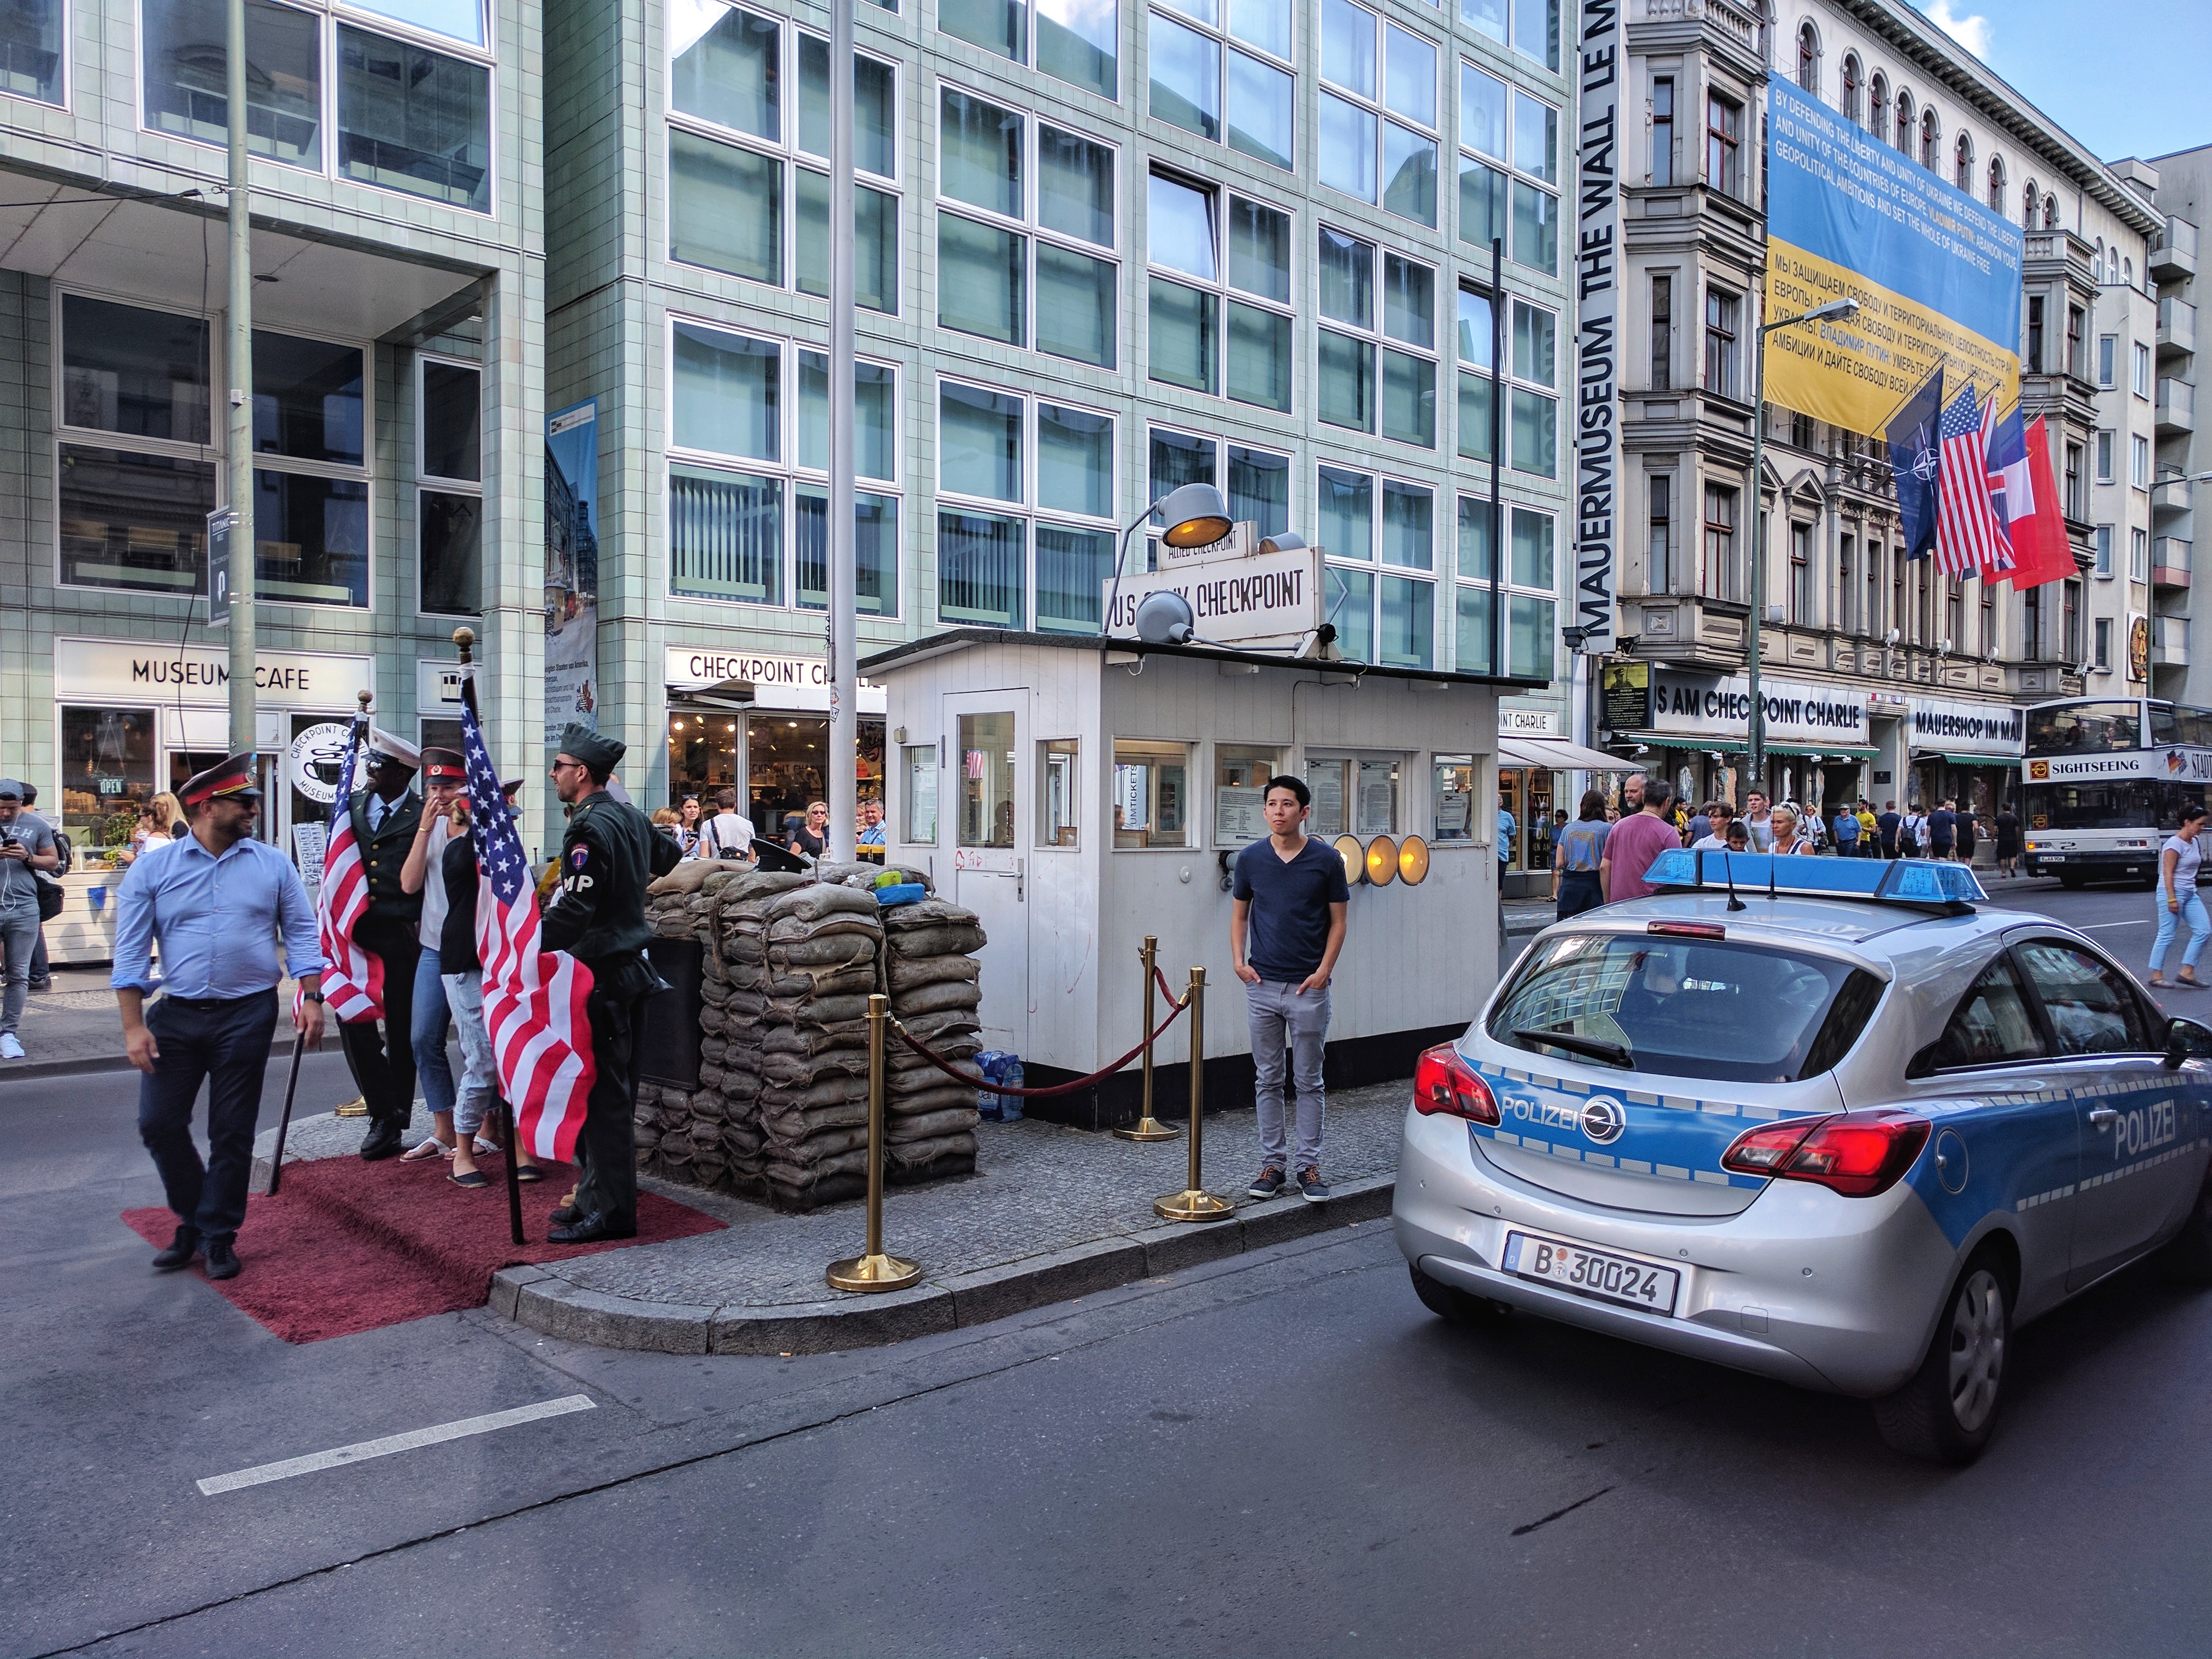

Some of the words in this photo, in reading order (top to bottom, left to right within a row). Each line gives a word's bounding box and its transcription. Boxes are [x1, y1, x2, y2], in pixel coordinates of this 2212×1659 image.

[1584, 44, 1615, 93] LE
[1582, 104, 1614, 222] WALL
[1775, 88, 1788, 109] BY
[1789, 97, 1834, 138] DEFENDING
[1836, 126, 1850, 149] THE
[1851, 136, 1880, 165] LIBERTY
[1881, 155, 1895, 176] AND
[1897, 162, 1916, 187] UNITY
[1917, 176, 1926, 192] OF
[1926, 182, 1952, 211] UKRAINE
[1953, 199, 1963, 217] WE
[1964, 205, 1987, 231] DEFEND
[1987, 219, 1997, 239] THE
[1998, 227, 2019, 251] LIBERTY
[1775, 115, 1794, 137] AND
[1796, 125, 1820, 152] UNITY
[1821, 140, 1832, 159] OF
[1833, 148, 1848, 170] THE
[1849, 159, 1889, 194] COUNTRIES
[1890, 182, 1900, 199] OF
[1928, 205, 1956, 234] VLADIMIR
[1976, 234, 2002, 262] ABANDON
[1775, 140, 1836, 187] GEOPOLITICAL
[1837, 174, 1876, 209] AMBITIONS
[1877, 196, 1892, 216] AND
[1893, 205, 1906, 224] SET
[1907, 212, 1920, 232] THE
[1921, 220, 1941, 246] WHOLE
[1942, 235, 1951, 250] OF
[1951, 239, 1976, 267] UKRAINE
[1977, 255, 1991, 276] FREE.
[1581, 224, 1612, 301] THE
[1775, 253, 1791, 274] МЫ
[1793, 261, 1845, 297] ЗАЩИЩАЕМ
[1847, 285, 1882, 313] СВОБОДУ
[1883, 302, 1888, 315] И
[1890, 304, 1954, 346] ТЕРРИТОРИАЛЬНУЮ
[1955, 336, 1995, 366] ЦЕЛОСТНОСТЬ
[1862, 316, 1895, 345] СВОБОДУ
[1898, 332, 1902, 346] И
[1773, 331, 1815, 360] АМБИЦИИ
[1818, 347, 1822, 363] И
[1824, 351, 1852, 375] ДАЙТЕ
[1853, 361, 1888, 389] СВОБОДУ
[1890, 375, 1909, 396] ВСЕЙ
[1820, 323, 1864, 353] ВЛАДИМИР
[1893, 352, 1924, 375] УМЕРЬТЕ
[1579, 314, 1613, 636] MAUERMUSEUM
[1197, 569, 1304, 618] CHECKPOINT
[133, 659, 230, 686] MUSEUM
[255, 667, 310, 690] CAFE
[690, 655, 804, 684] CHECKPOINT
[1498, 713, 1512, 727] INT
[1515, 714, 1547, 729] CHARLIE
[1655, 685, 1667, 714] S
[1672, 687, 1700, 716] AM
[1704, 690, 1801, 724] CHECOINT
[1804, 700, 1859, 728] CHARLIE
[1915, 712, 1982, 738] MAUERSHOP
[1984, 722, 1998, 741] IM
[2000, 720, 2022, 742] MAU
[291, 725, 337, 759] CHECKPOINT
[100, 781, 122, 793] OPEN
[299, 780, 337, 800] MUSEUM
[2052, 760, 2139, 775] SIGHTSEEING
[564, 875, 594, 893] MP
[1501, 1095, 1579, 1131] POLIZEI
[2115, 1098, 2176, 1160] POLIZEI
[1534, 1244, 1553, 1274] B
[1570, 1252, 1658, 1302] 30024
